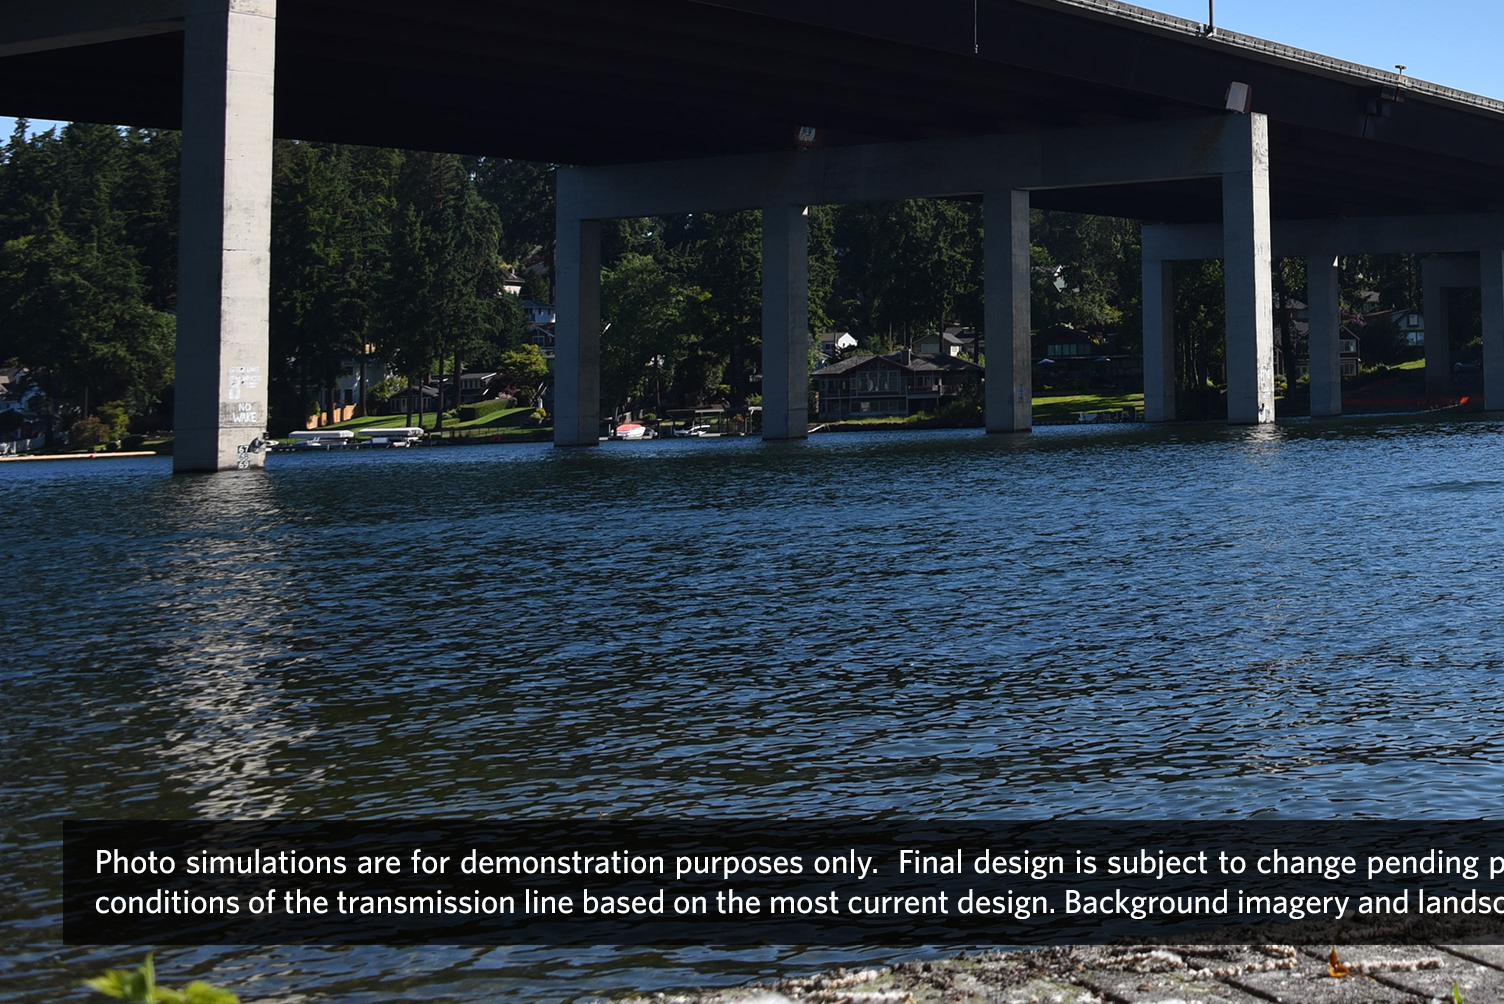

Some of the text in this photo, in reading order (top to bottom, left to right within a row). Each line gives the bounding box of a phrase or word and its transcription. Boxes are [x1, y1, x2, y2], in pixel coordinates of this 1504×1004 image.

[238, 403, 252, 412] NO
[232, 412, 256, 423] WAKE
[238, 445, 249, 453] 67
[238, 461, 249, 469] 69
